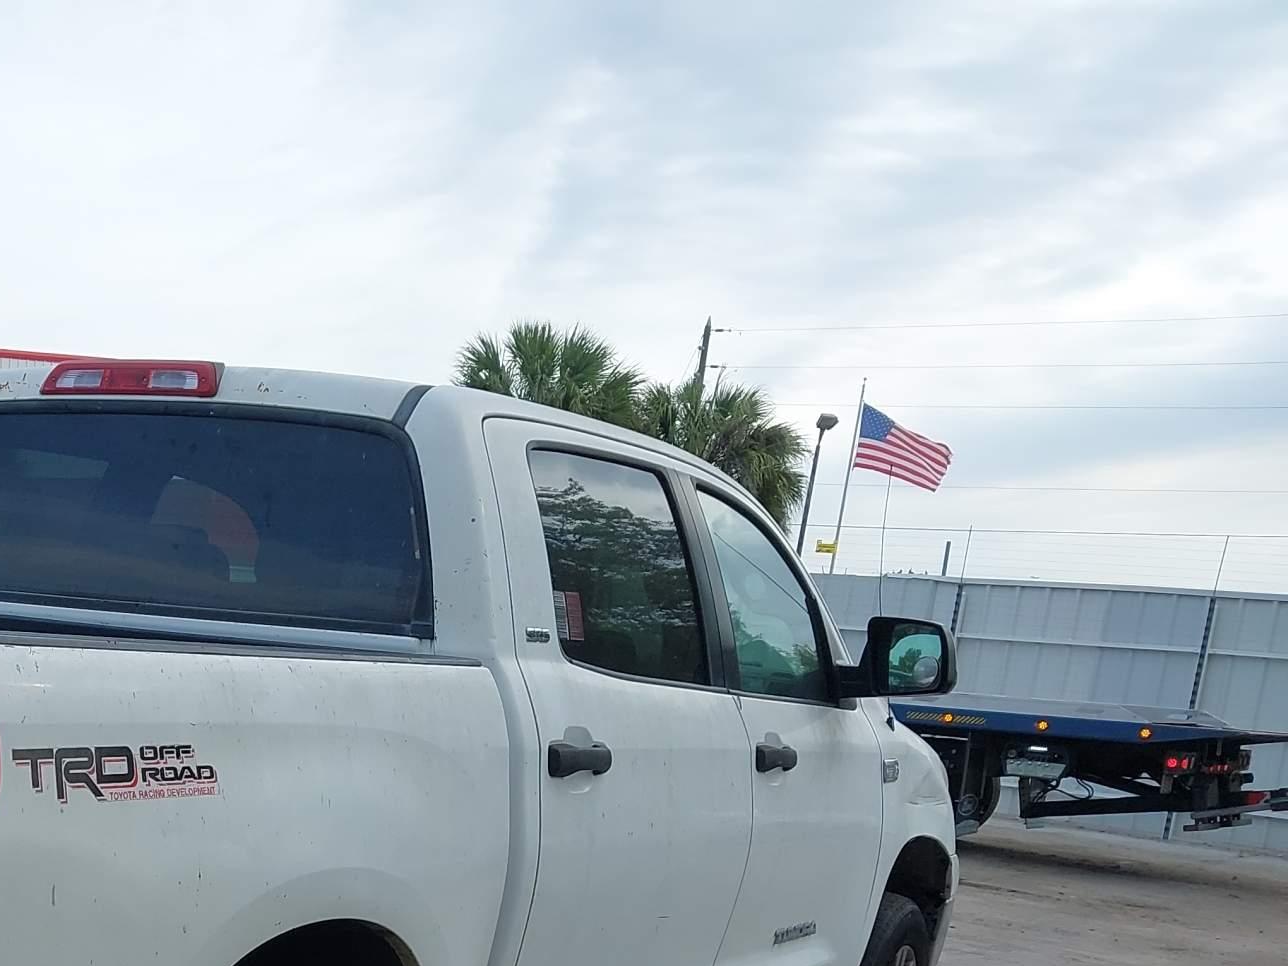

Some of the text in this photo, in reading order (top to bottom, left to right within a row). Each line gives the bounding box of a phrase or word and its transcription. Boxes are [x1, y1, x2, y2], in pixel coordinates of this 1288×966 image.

[140, 745, 194, 763] OFF
[12, 746, 137, 803] TRD
[141, 765, 217, 784] ROAD
[109, 786, 215, 801] TOYOTA RACING DEVELOPMENT
